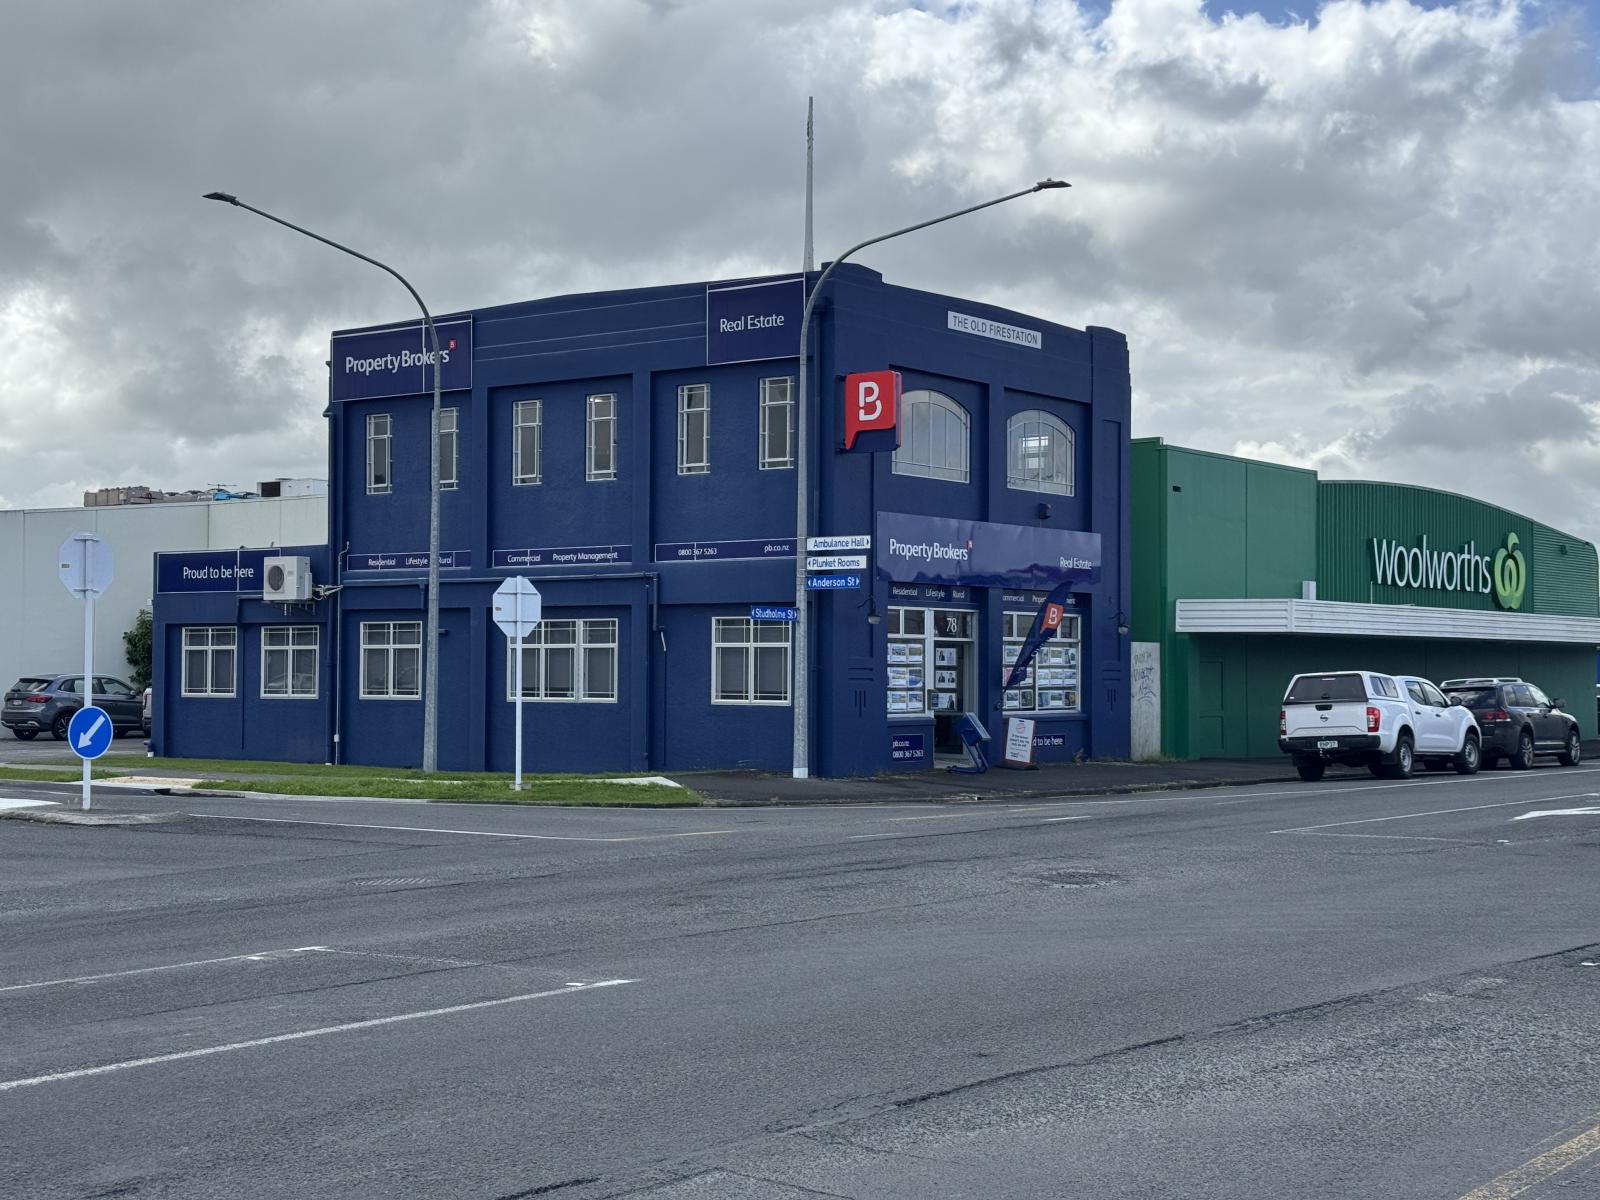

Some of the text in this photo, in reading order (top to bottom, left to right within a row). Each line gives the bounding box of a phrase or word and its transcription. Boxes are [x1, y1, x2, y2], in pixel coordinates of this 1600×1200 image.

[719, 313, 785, 333] Real Estate
[952, 315, 1038, 345] THE OLD FIRESTATION
[345, 353, 401, 376] Property
[858, 381, 882, 421] B
[764, 543, 790, 553] pb.co.nz
[813, 537, 865, 548] Ambulance Hall
[677, 548, 692, 556] 0800
[703, 547, 718, 555] 5263
[889, 538, 968, 562] Property Brokers
[368, 558, 396, 566] Residential
[405, 557, 428, 566] Lifestyle
[507, 551, 618, 563] Commercial Property Management
[812, 558, 860, 567] Plunket Rooms
[1059, 556, 1092, 570] Real Estate
[1373, 534, 1492, 594] Woolworths
[183, 564, 254, 579] Proud to be here
[812, 577, 855, 587] Anderson St
[892, 586, 965, 599] Residential Lifestyle Rural
[755, 608, 794, 619] Studholme St
[946, 617, 957, 633] 78
[1037, 737, 1044, 746] to
[1044, 736, 1051, 746] be
[1051, 736, 1063, 745] here
